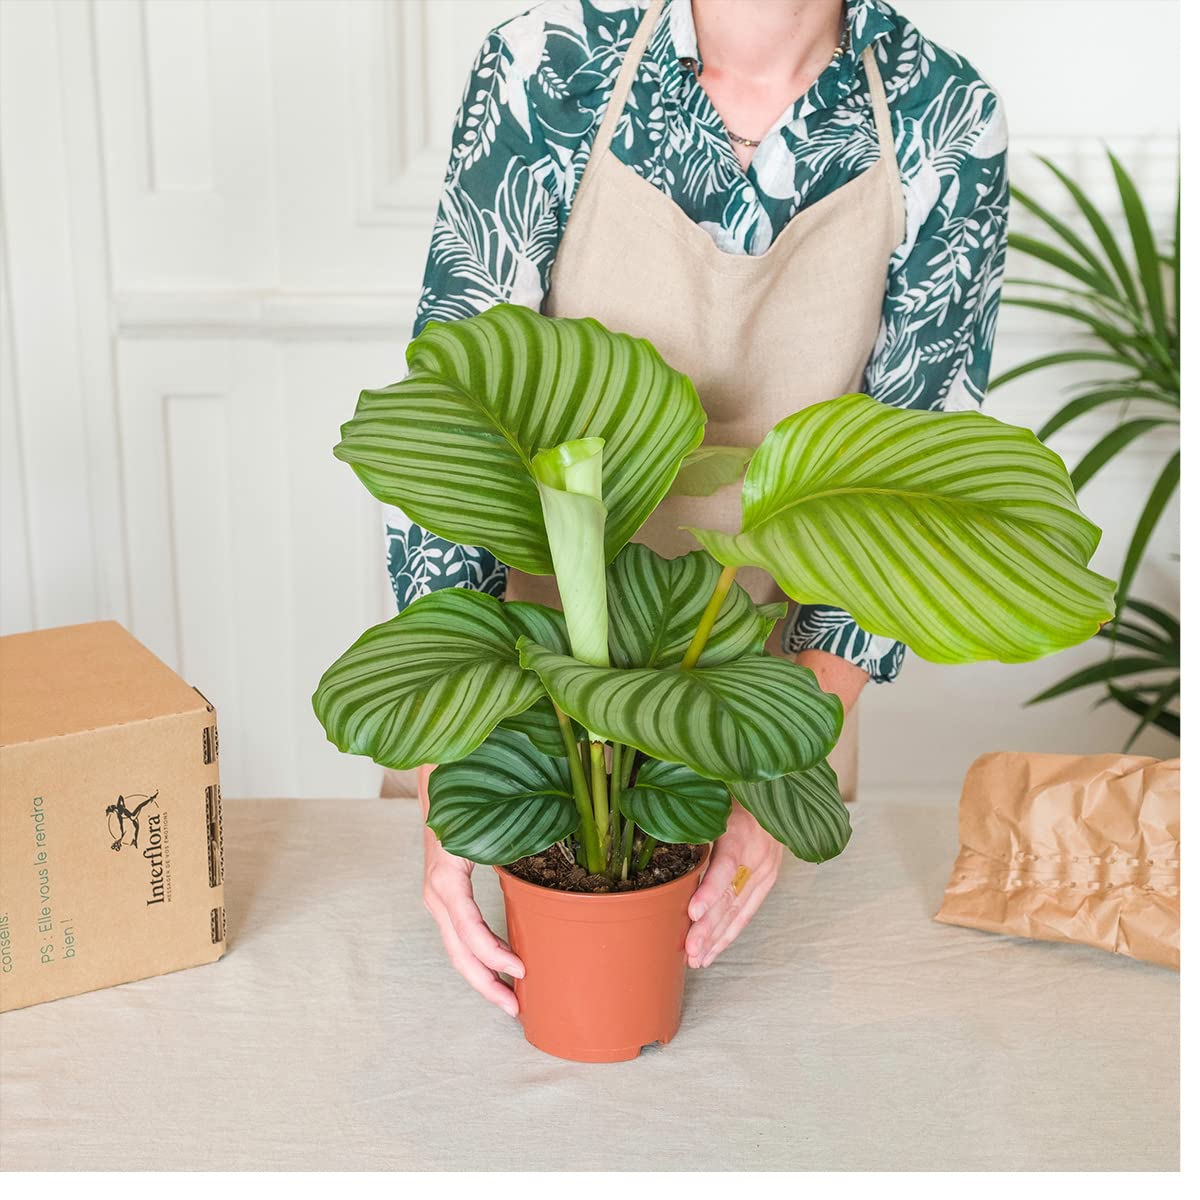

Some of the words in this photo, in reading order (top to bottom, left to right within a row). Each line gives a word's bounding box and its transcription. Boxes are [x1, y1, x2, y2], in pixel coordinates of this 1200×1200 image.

[30, 796, 46, 847] rendra
[34, 852, 47, 866] le
[143, 814, 164, 906] Interflora
[39, 868, 50, 903] vous
[39, 907, 52, 933] Elle
[41, 944, 54, 964] PS
[62, 926, 76, 959] bien
